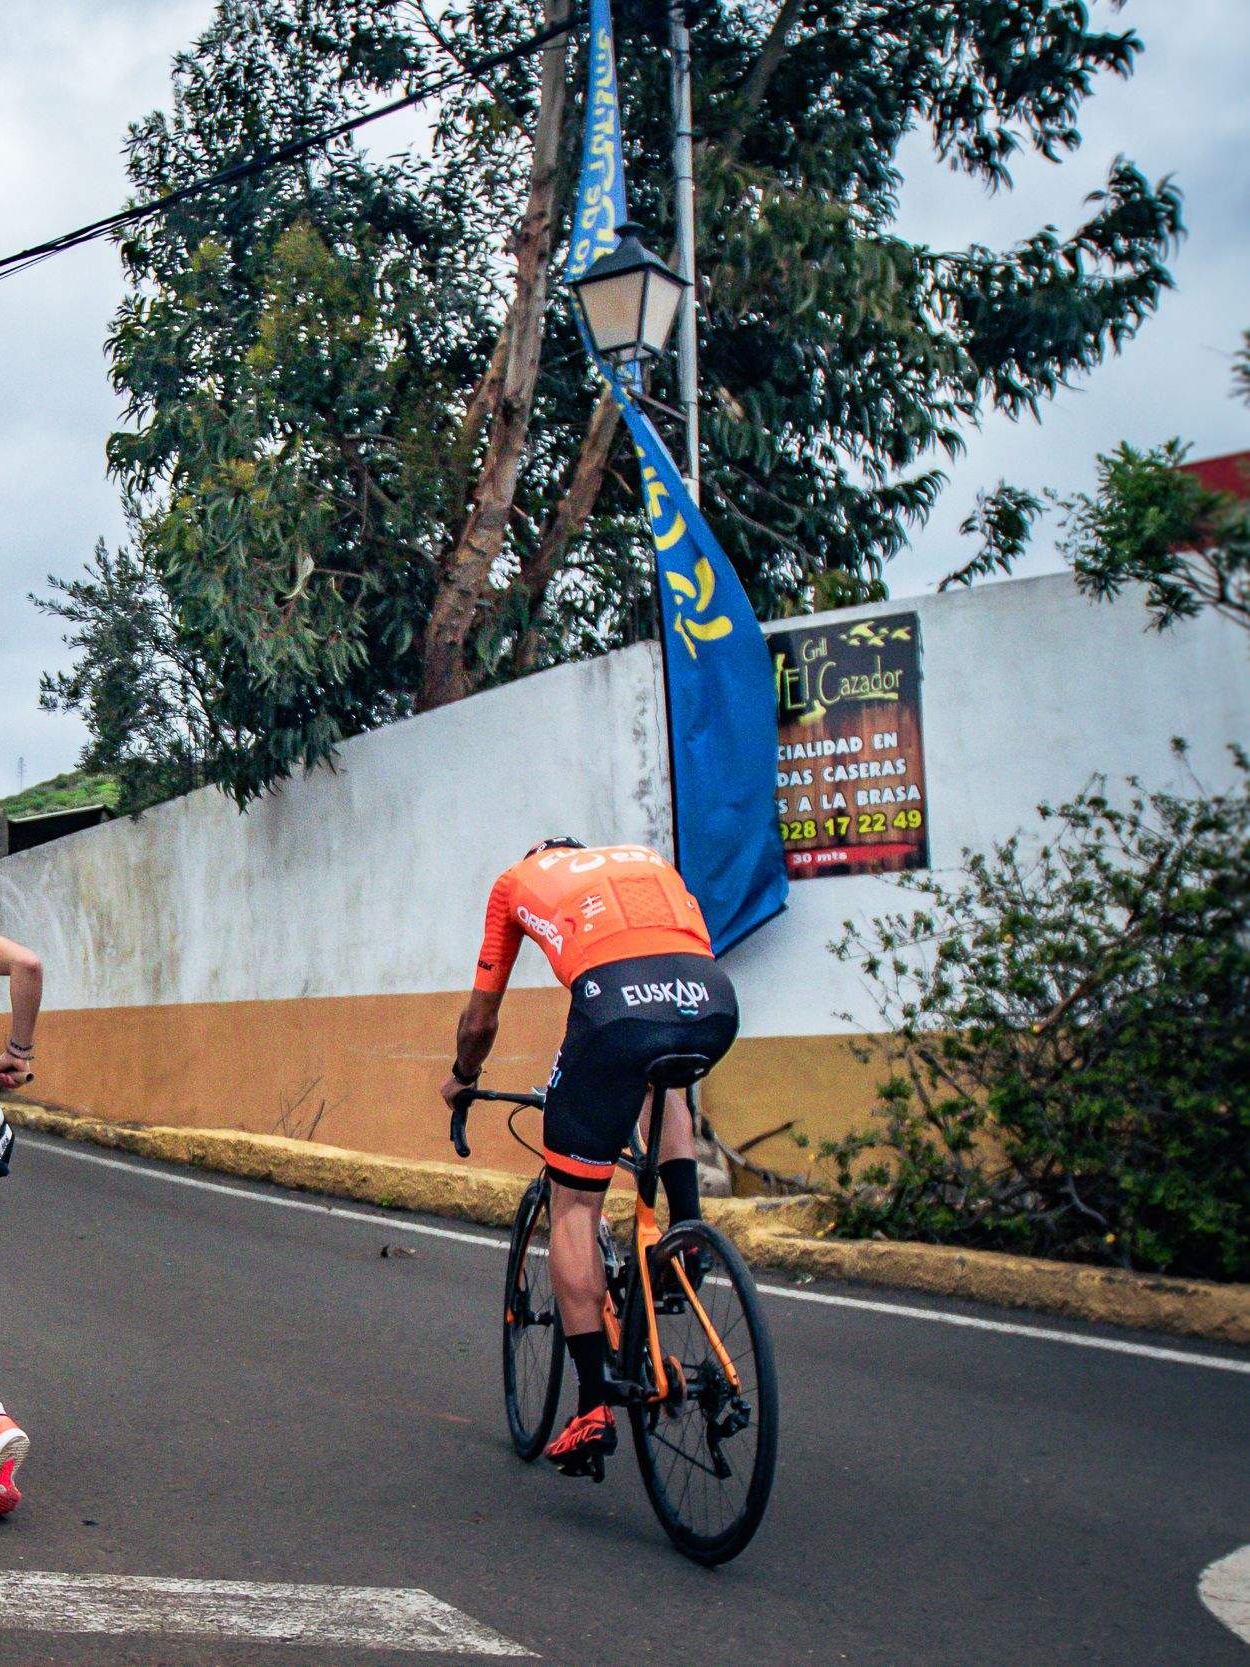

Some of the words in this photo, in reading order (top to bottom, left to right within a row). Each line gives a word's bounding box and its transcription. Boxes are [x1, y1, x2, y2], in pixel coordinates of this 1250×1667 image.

[802, 638, 827, 662] Grill
[784, 665, 810, 710] El
[817, 655, 903, 705] Cazador
[777, 736, 864, 761] CIALIDAD
[872, 732, 898, 749] EN
[776, 768, 814, 787] DAS
[822, 758, 907, 783] CASERAS
[798, 795, 812, 812] A
[821, 792, 847, 810] LA
[856, 784, 921, 806] BRASA
[824, 816, 851, 836] 17
[858, 813, 887, 834] 22
[893, 809, 922, 829] 49
[517, 905, 564, 955] ORBEA
